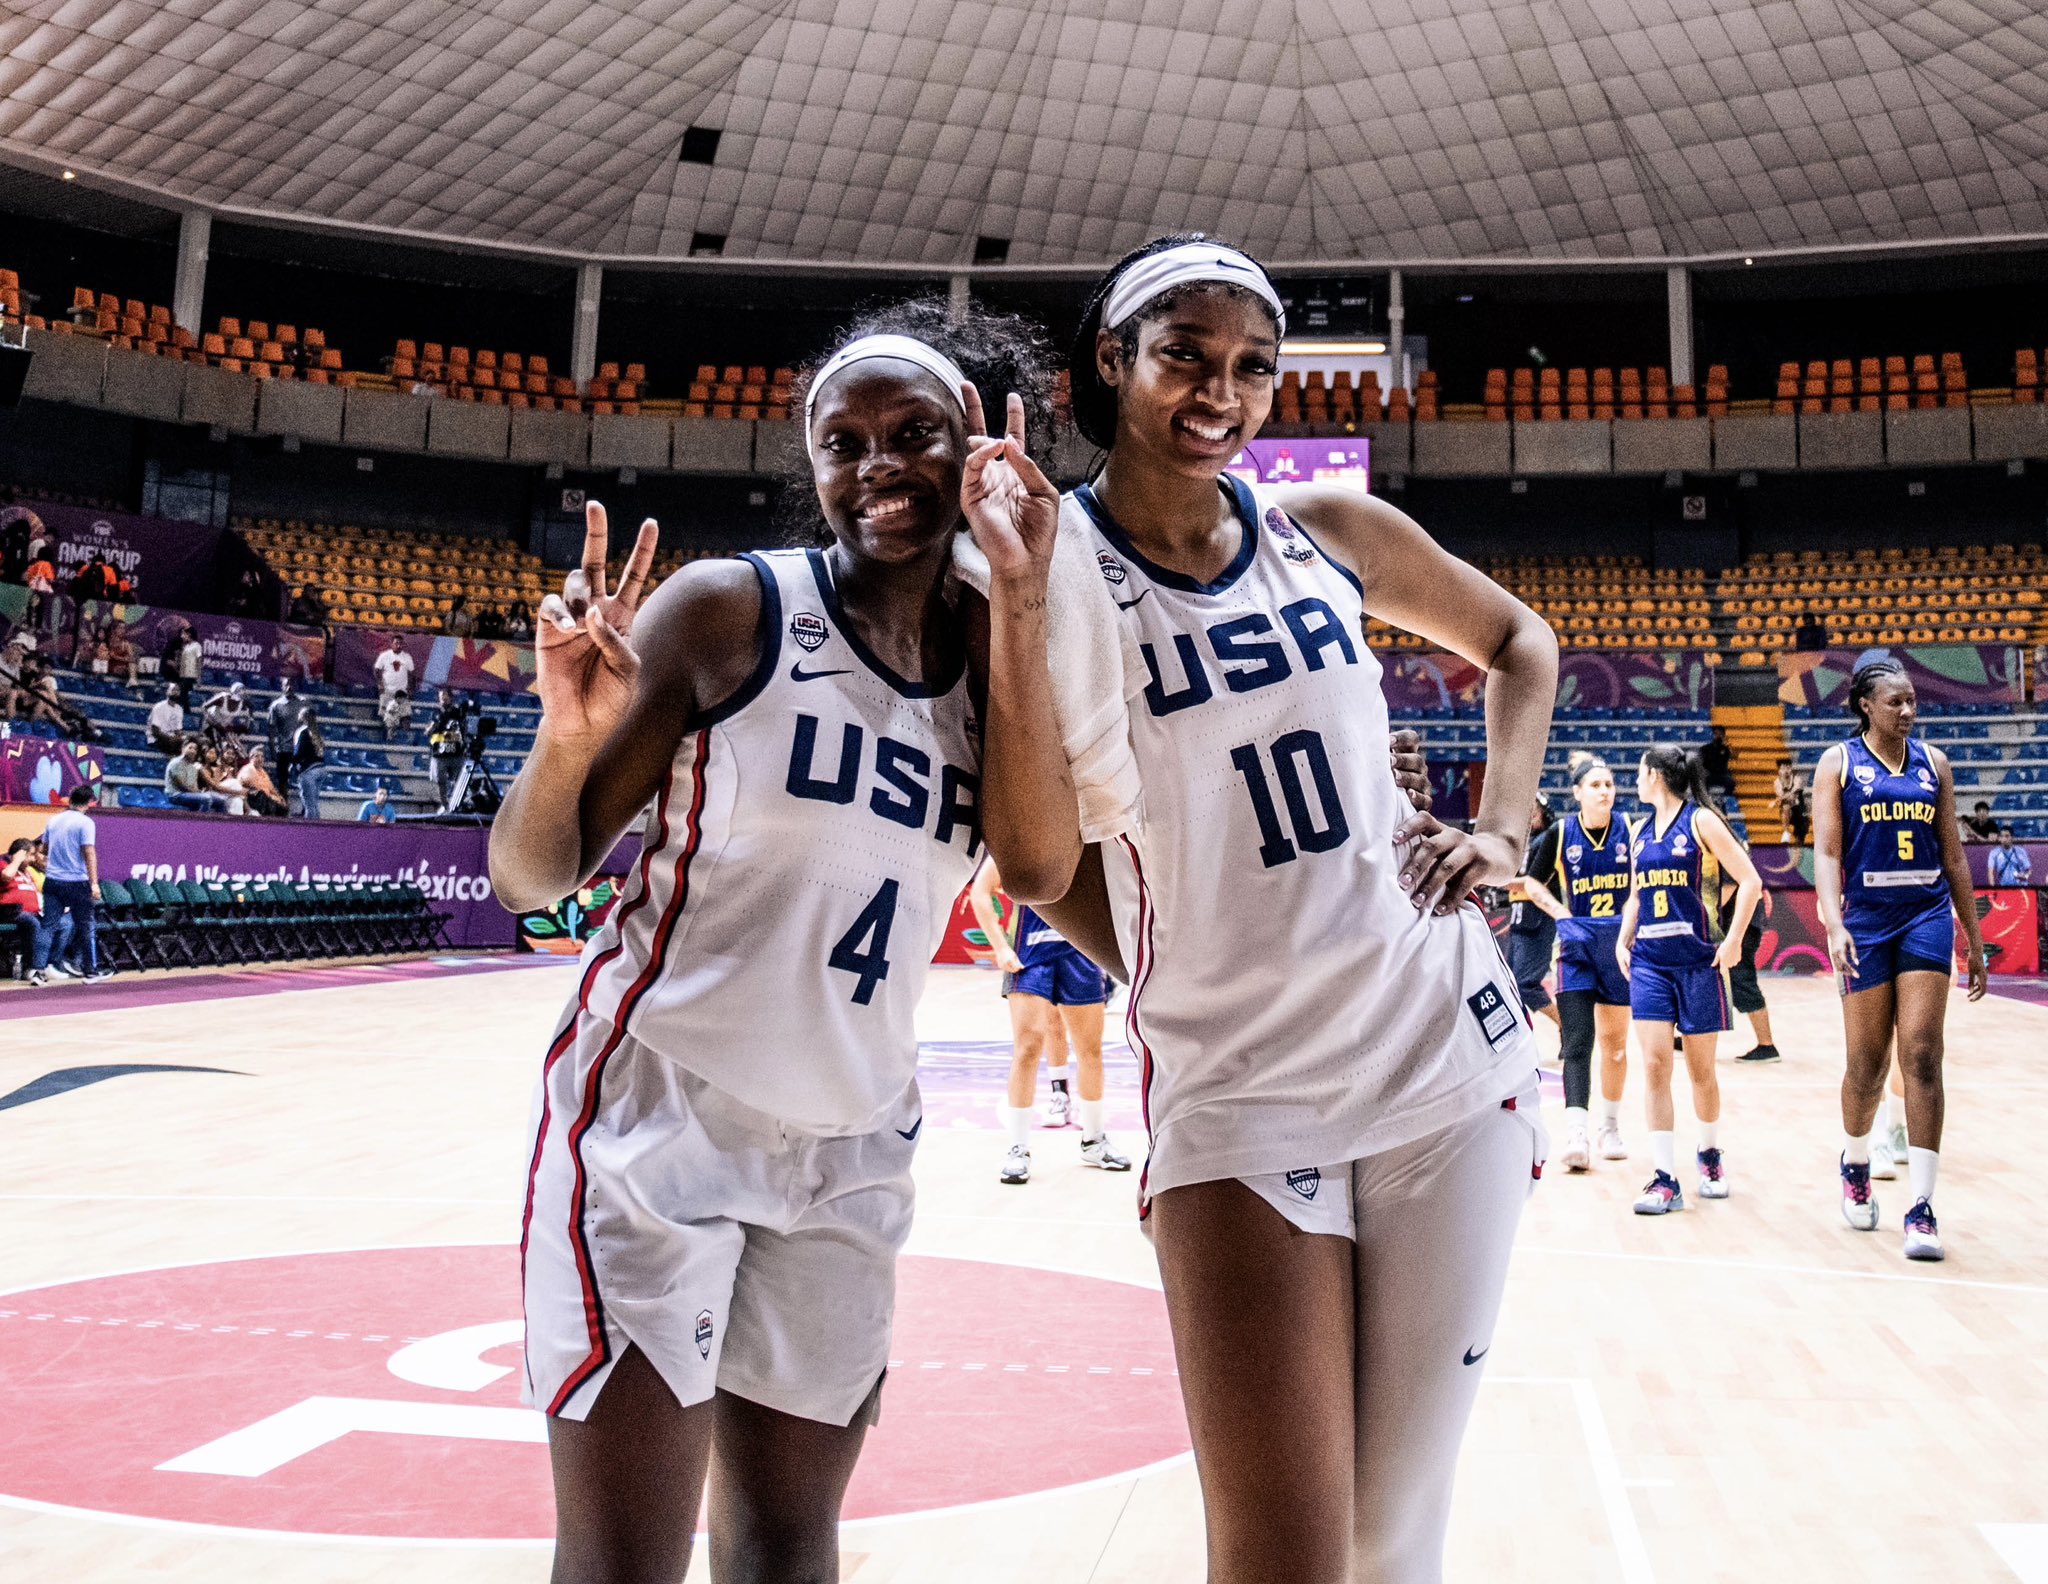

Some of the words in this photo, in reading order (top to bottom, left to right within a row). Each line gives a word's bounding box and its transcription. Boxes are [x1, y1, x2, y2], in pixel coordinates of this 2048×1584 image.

[797, 617, 822, 631] USA
[203, 639, 262, 660] AMERICUP
[1140, 597, 1359, 717] USA
[786, 714, 983, 859] USA
[1230, 729, 1351, 868] 10
[1897, 830, 1914, 861] 5
[1635, 869, 1689, 891] OLOMBIA
[1590, 893, 1615, 918] 22
[1653, 890, 1669, 918] 8
[827, 877, 900, 1007] 4
[1479, 990, 1497, 1011] 48
